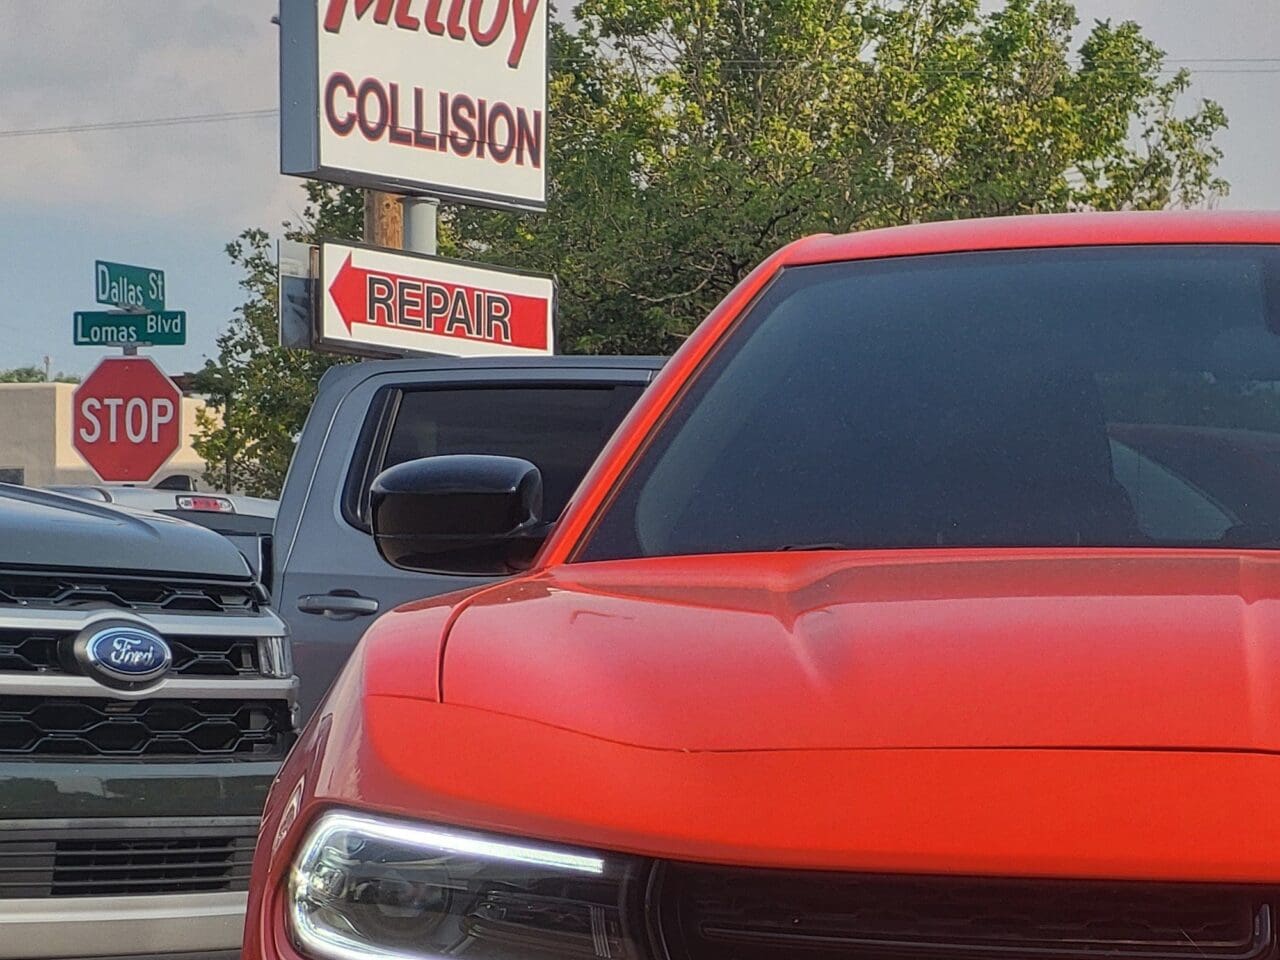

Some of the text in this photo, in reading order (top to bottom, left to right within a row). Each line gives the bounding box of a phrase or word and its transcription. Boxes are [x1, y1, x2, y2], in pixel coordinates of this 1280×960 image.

[324, 71, 542, 168] COLLISION
[98, 264, 163, 306] Dallas St
[77, 314, 181, 342] Lomas Blvd
[366, 275, 512, 343] REPAIR
[79, 397, 174, 443] STOP
[111, 637, 155, 666] Ford
